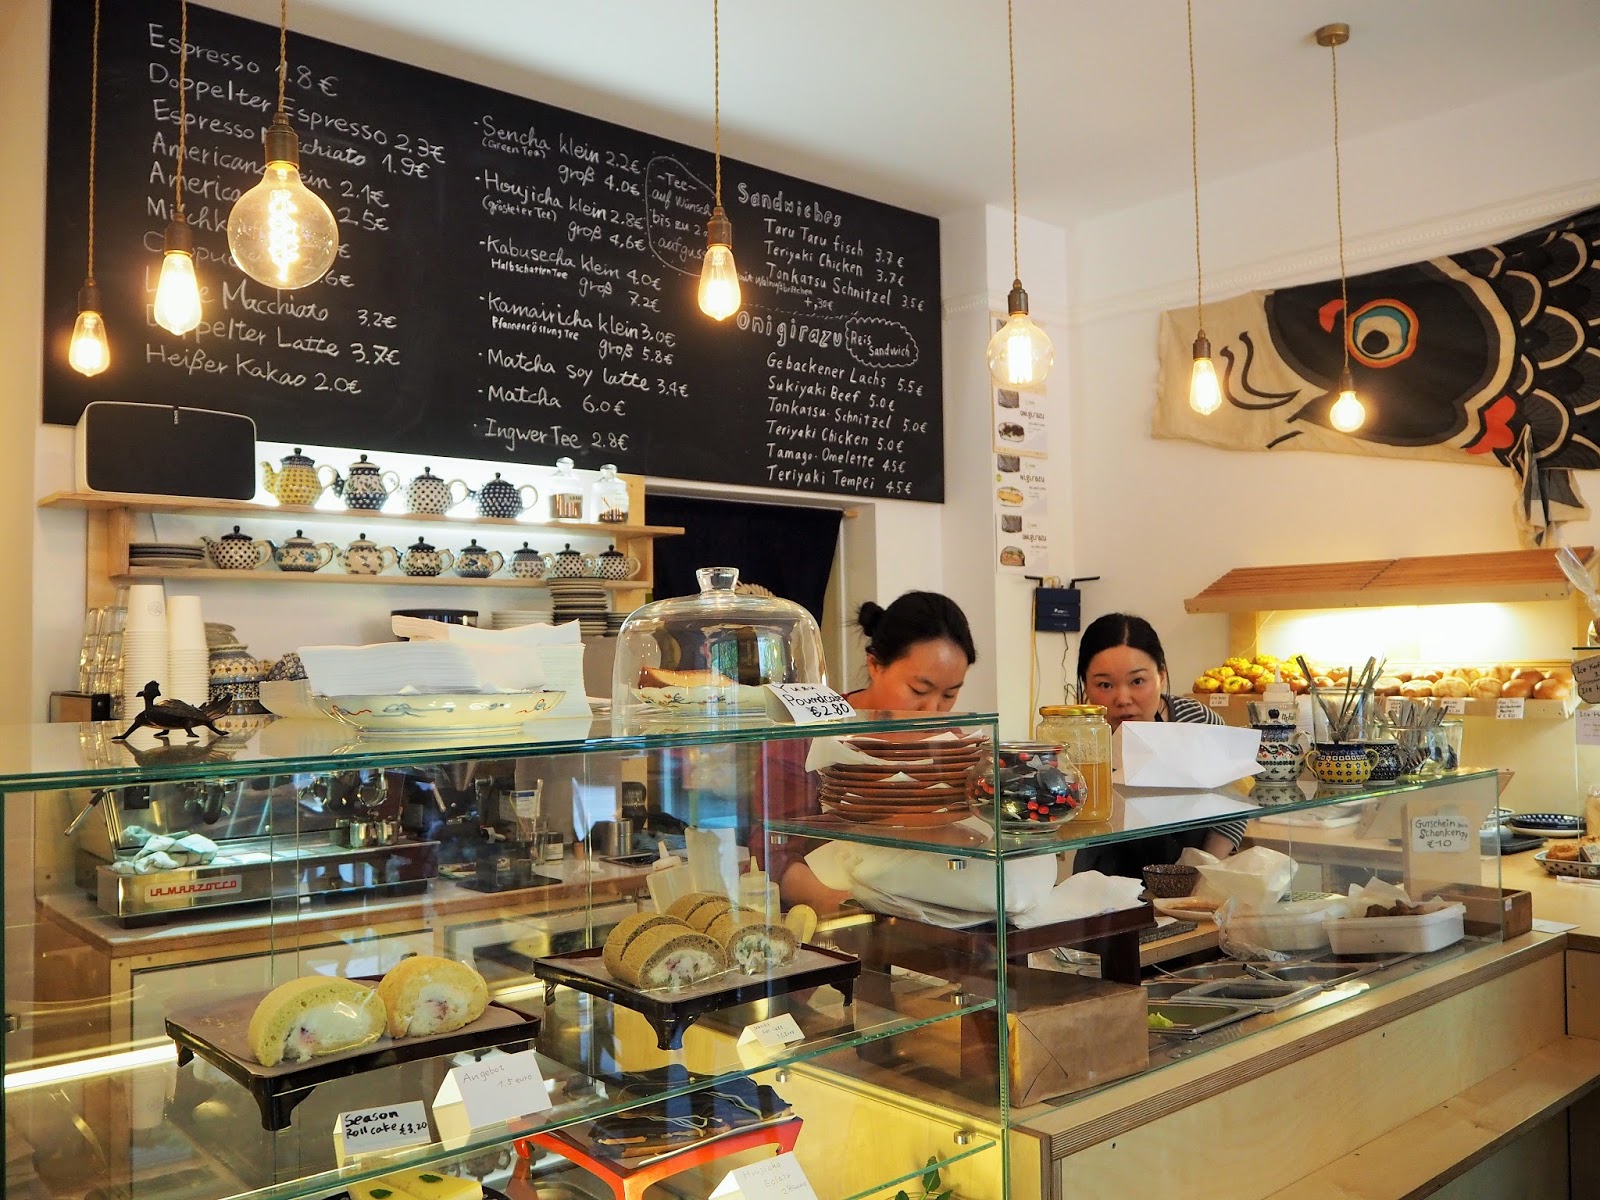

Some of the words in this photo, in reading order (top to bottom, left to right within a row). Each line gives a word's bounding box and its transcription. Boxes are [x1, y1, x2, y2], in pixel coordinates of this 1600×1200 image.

[149, 23, 259, 73] Espresso
[149, 62, 271, 113] Doppelter
[280, 96, 388, 145] Espresso
[395, 134, 446, 164] 2.3€
[153, 99, 255, 140] Espresso
[381, 154, 430, 178] 1.9€
[482, 137, 519, 153] (Green
[522, 146, 546, 158] Tea)
[483, 115, 551, 150] Sencha
[559, 132, 599, 163] klein
[605, 151, 641, 174] 2.2€
[340, 180, 389, 208] 2.1€
[558, 165, 595, 186] groß
[604, 175, 641, 195] 4.0€
[484, 168, 563, 208] Houjicha
[569, 195, 606, 222] klein
[610, 209, 644, 230] 2.8€
[652, 189, 672, 210] auf
[737, 182, 842, 227] Sandwiches
[338, 205, 389, 231] 2.5€
[568, 221, 602, 242] groß
[652, 208, 670, 227] bis
[763, 218, 795, 239] Taru
[800, 226, 827, 246] Taru
[833, 236, 864, 257] fisch
[487, 235, 575, 268] Kabusecha
[581, 254, 620, 280] klein
[626, 270, 662, 291] 4.0€
[763, 240, 814, 264] Teriyaki
[819, 253, 863, 277] Chicken
[579, 276, 613, 297] groß
[628, 290, 661, 312] 7.2€
[766, 261, 827, 289] Tonkatsu
[833, 277, 892, 305] Schnitzel
[901, 295, 925, 312] 3.5€
[222, 278, 328, 321] Macchiato
[357, 309, 397, 329] 3.2€
[488, 292, 593, 328] Kamairicha
[599, 312, 638, 339] klein
[564, 329, 579, 341] Tee
[737, 310, 843, 347] Onigirazu
[851, 330, 871, 345] Reis
[277, 326, 339, 357] Latte
[350, 342, 401, 365] 3.7€
[599, 339, 634, 361] groß
[642, 348, 674, 365] 5.8€
[869, 343, 910, 357] Sandwich
[146, 343, 229, 375] Heißer
[236, 353, 306, 387] Kakao
[314, 372, 361, 394] 2.0€
[488, 348, 555, 374] Matcha
[566, 364, 593, 386] soy
[603, 367, 650, 391] latte
[766, 352, 845, 379] Gebackener
[850, 367, 887, 388] Lachs
[897, 378, 923, 396] 5.5€
[488, 385, 562, 408] Matcha
[768, 375, 826, 399] Sukiyaki
[830, 385, 861, 402] Beef
[869, 394, 895, 412] 5.0€
[484, 417, 547, 451] Ingwer
[550, 425, 582, 449] Tee
[592, 431, 629, 451] 2.8€
[834, 408, 892, 429] Schnitzel
[902, 418, 928, 433] 5.0€
[766, 420, 816, 440] Teriyaki
[821, 427, 869, 447] Chicken
[876, 437, 904, 453] 5.0€
[822, 447, 875, 468] Omelette
[766, 465, 826, 486] Teriyaki
[832, 469, 875, 491] Tempei
[1415, 819, 1456, 829] Gutschein
[1427, 839, 1452, 849] €10
[463, 1065, 505, 1083] Angebot
[515, 1075, 532, 1084] euro
[345, 1111, 399, 1128] Season
[346, 1126, 367, 1139] Roll
[371, 1122, 397, 1135] cake
